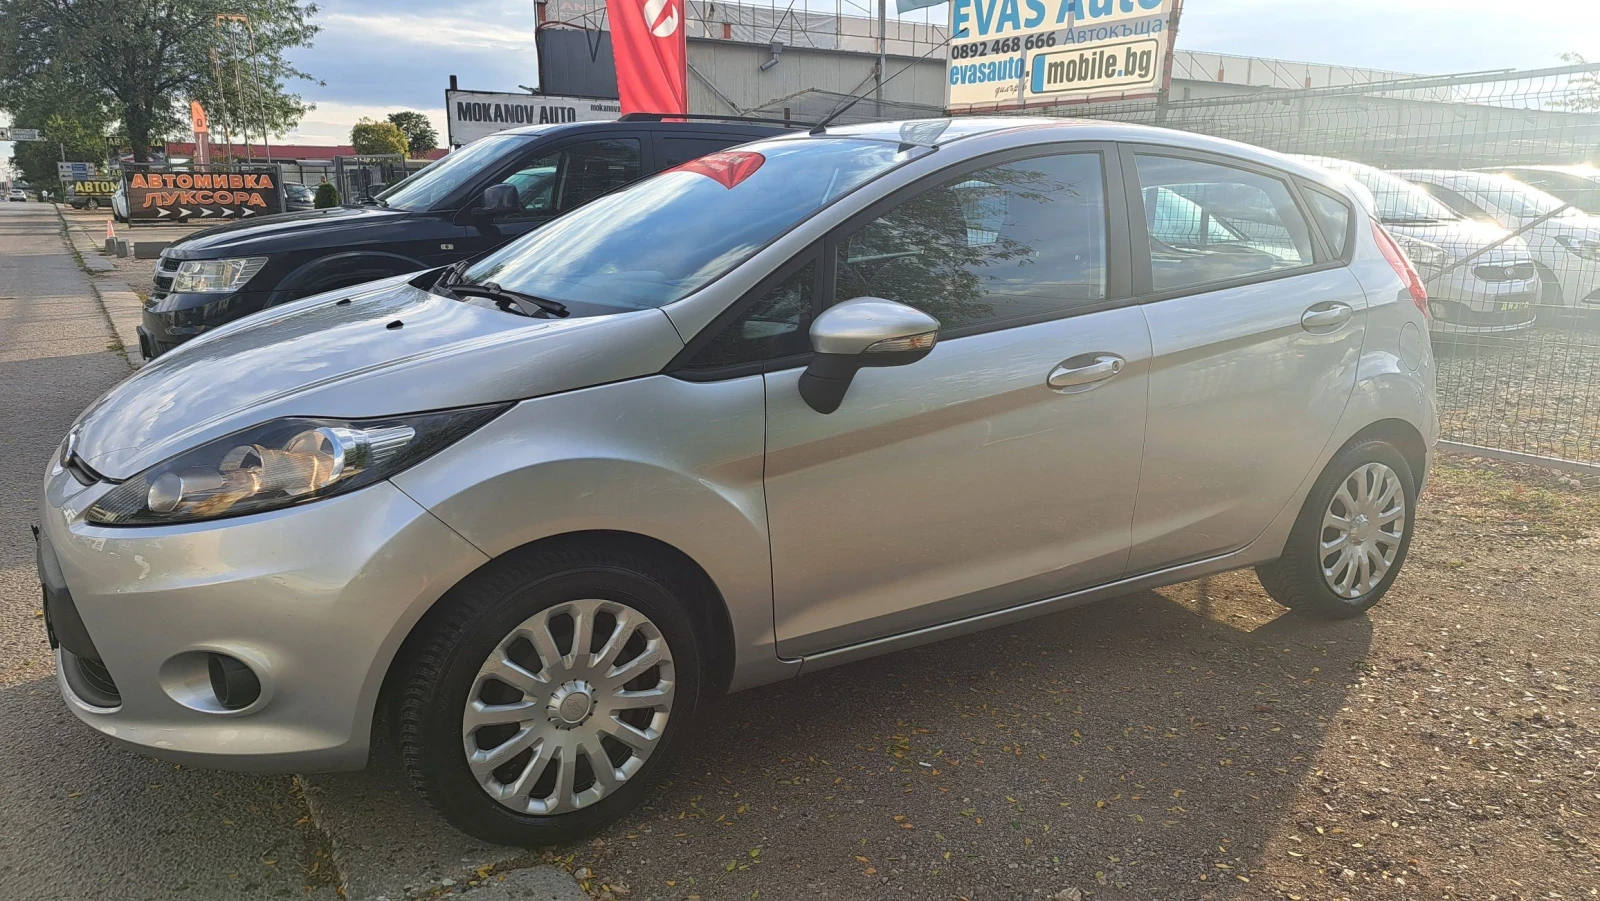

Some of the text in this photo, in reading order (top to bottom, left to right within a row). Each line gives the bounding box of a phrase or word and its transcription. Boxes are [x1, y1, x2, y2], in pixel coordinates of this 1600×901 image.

[952, 0, 1046, 39] EVAS
[1064, 18, 1163, 45] Автокъща
[951, 31, 1056, 60] 0892 468 666
[1047, 46, 1152, 85] mobile.bg
[456, 101, 576, 125] MOKANOV AUTO
[130, 173, 274, 189] АВТОМИВКА
[143, 190, 267, 208] ЛУКСОРА
